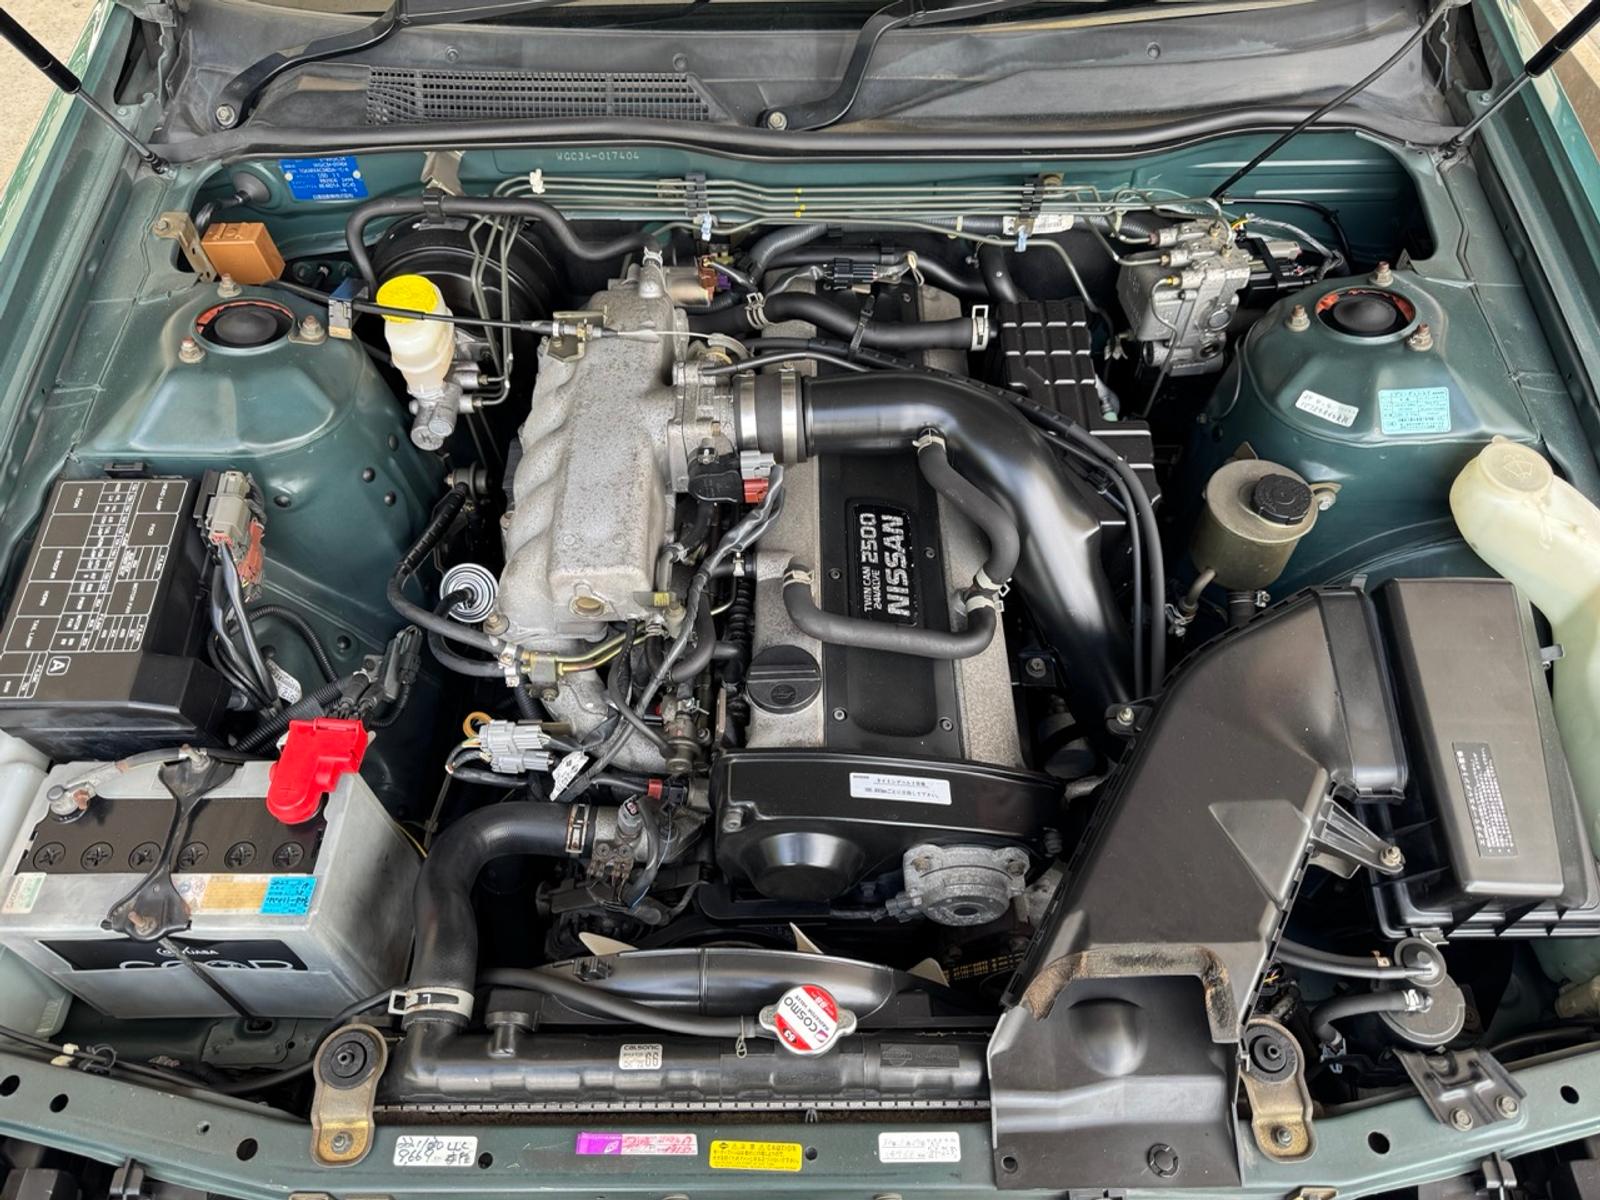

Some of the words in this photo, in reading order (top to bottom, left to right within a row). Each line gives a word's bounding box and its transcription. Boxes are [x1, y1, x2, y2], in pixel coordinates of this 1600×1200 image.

[860, 513, 879, 564] 2500
[862, 566, 871, 586] CAM
[881, 514, 910, 617] NISSAN
[863, 587, 872, 612] TWIN
[872, 569, 882, 610] 24VALVE
[50, 660, 65, 672] A
[784, 996, 818, 1033] COSMO
